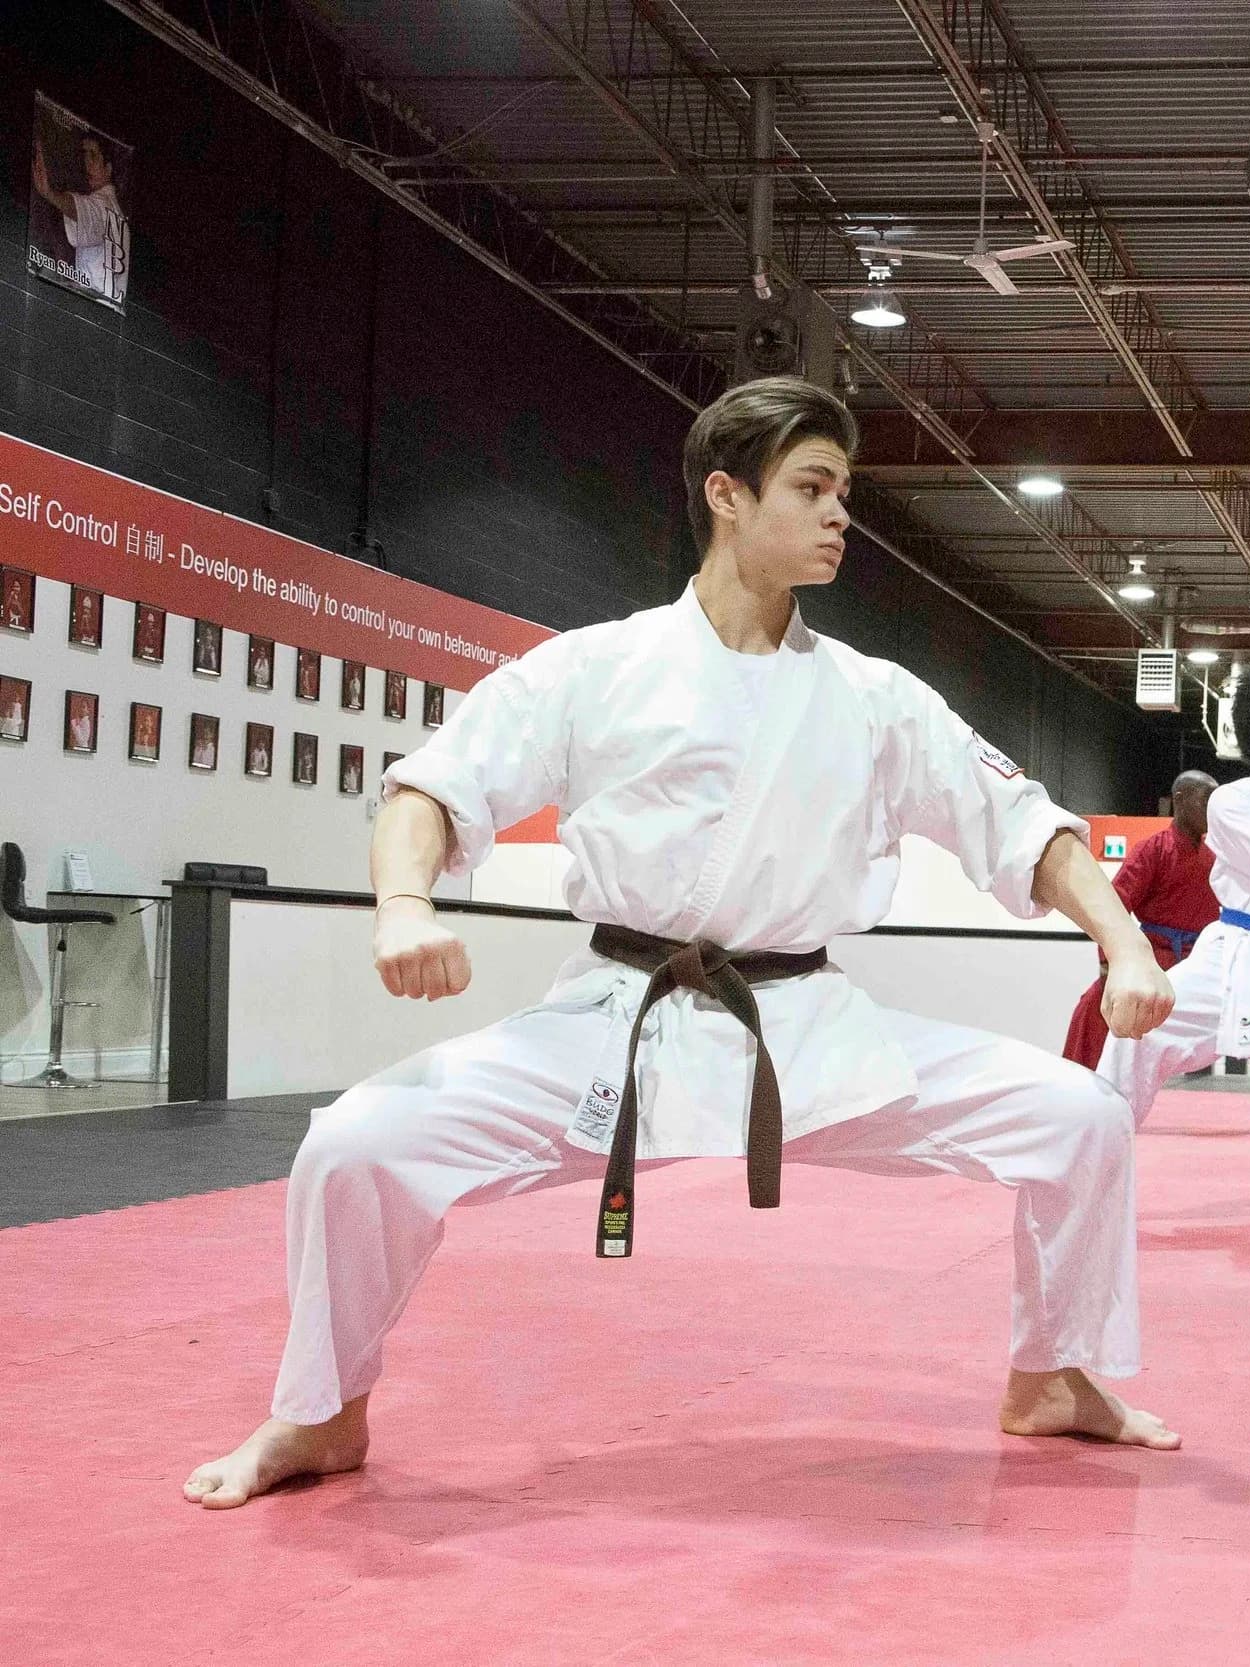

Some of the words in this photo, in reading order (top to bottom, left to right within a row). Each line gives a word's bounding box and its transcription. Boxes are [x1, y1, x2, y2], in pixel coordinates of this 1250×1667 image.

[29, 245, 56, 271] Ryan
[57, 260, 91, 288] Shields
[0, 483, 41, 522] Self
[46, 500, 118, 547] Control
[126, 523, 164, 564] 自制
[180, 543, 248, 592] Develop
[252, 568, 277, 596] the
[280, 579, 321, 616] ability
[324, 592, 338, 616] to
[341, 602, 385, 632] control
[388, 617, 415, 639] your
[418, 627, 441, 649] own
[444, 631, 497, 665] behaviour
